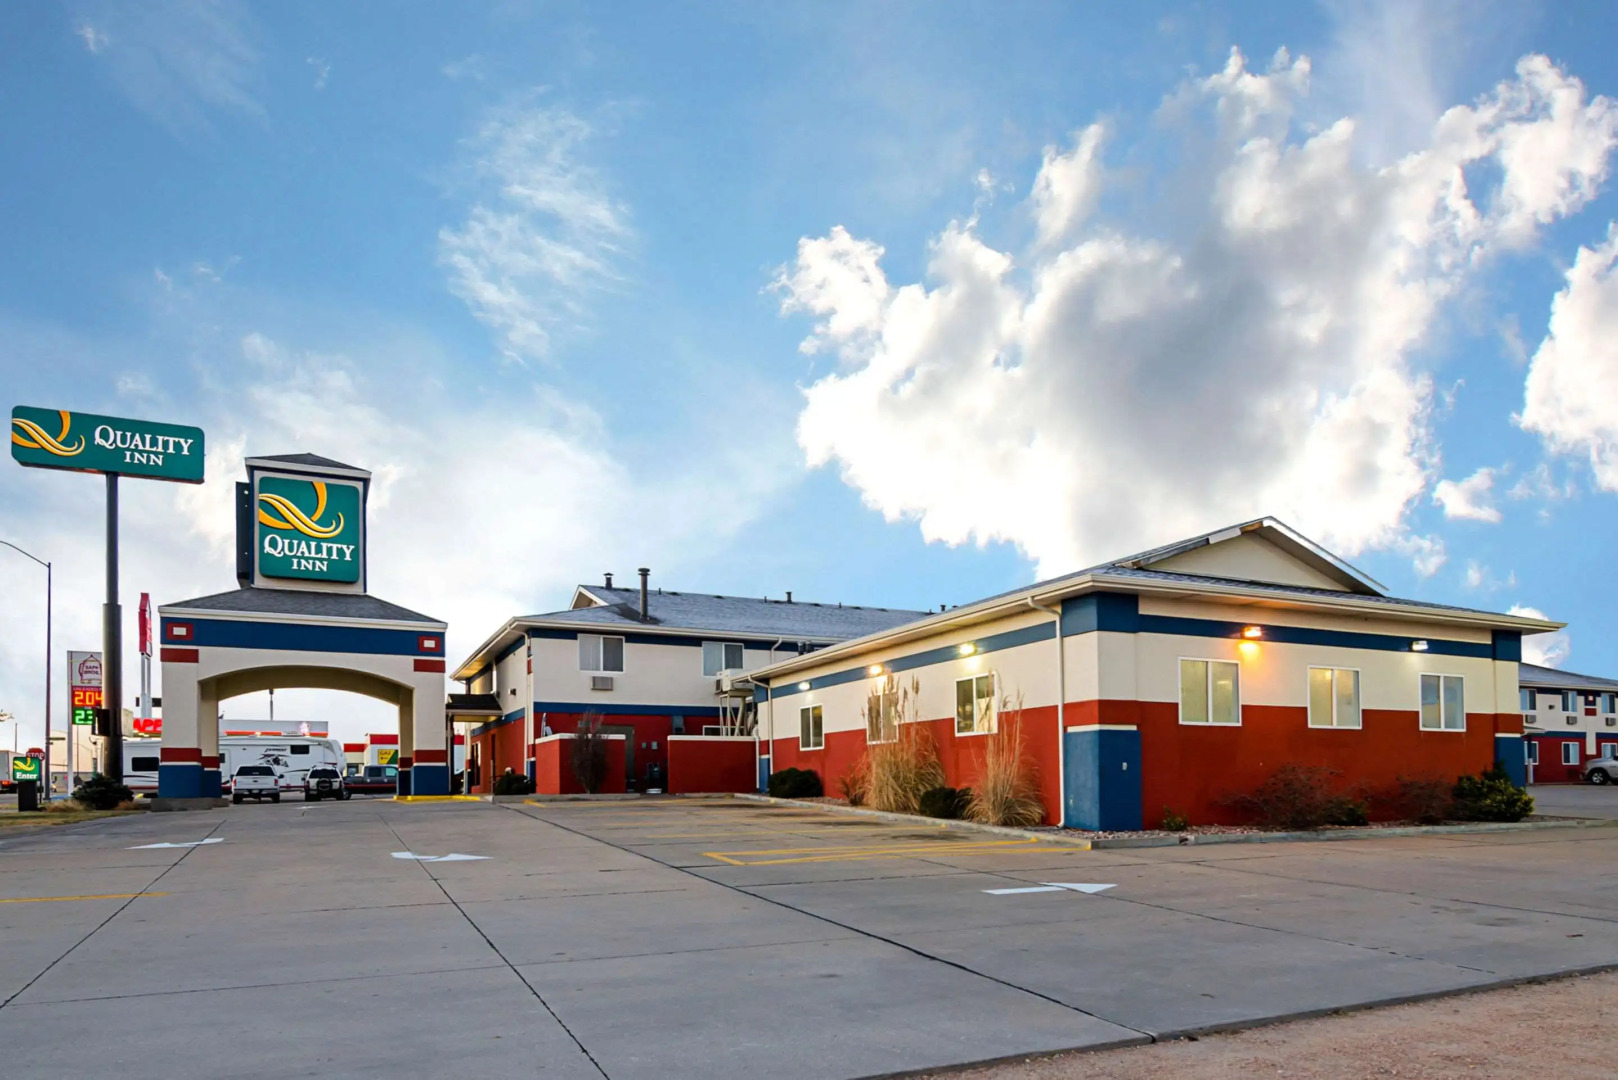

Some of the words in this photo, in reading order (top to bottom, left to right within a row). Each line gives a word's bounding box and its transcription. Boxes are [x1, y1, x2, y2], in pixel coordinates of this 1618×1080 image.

[94, 425, 194, 455] QUALITY
[124, 451, 164, 466] INN
[264, 534, 355, 561] QUALITY
[291, 558, 329, 572] INN
[16, 772, 38, 780] Enter
